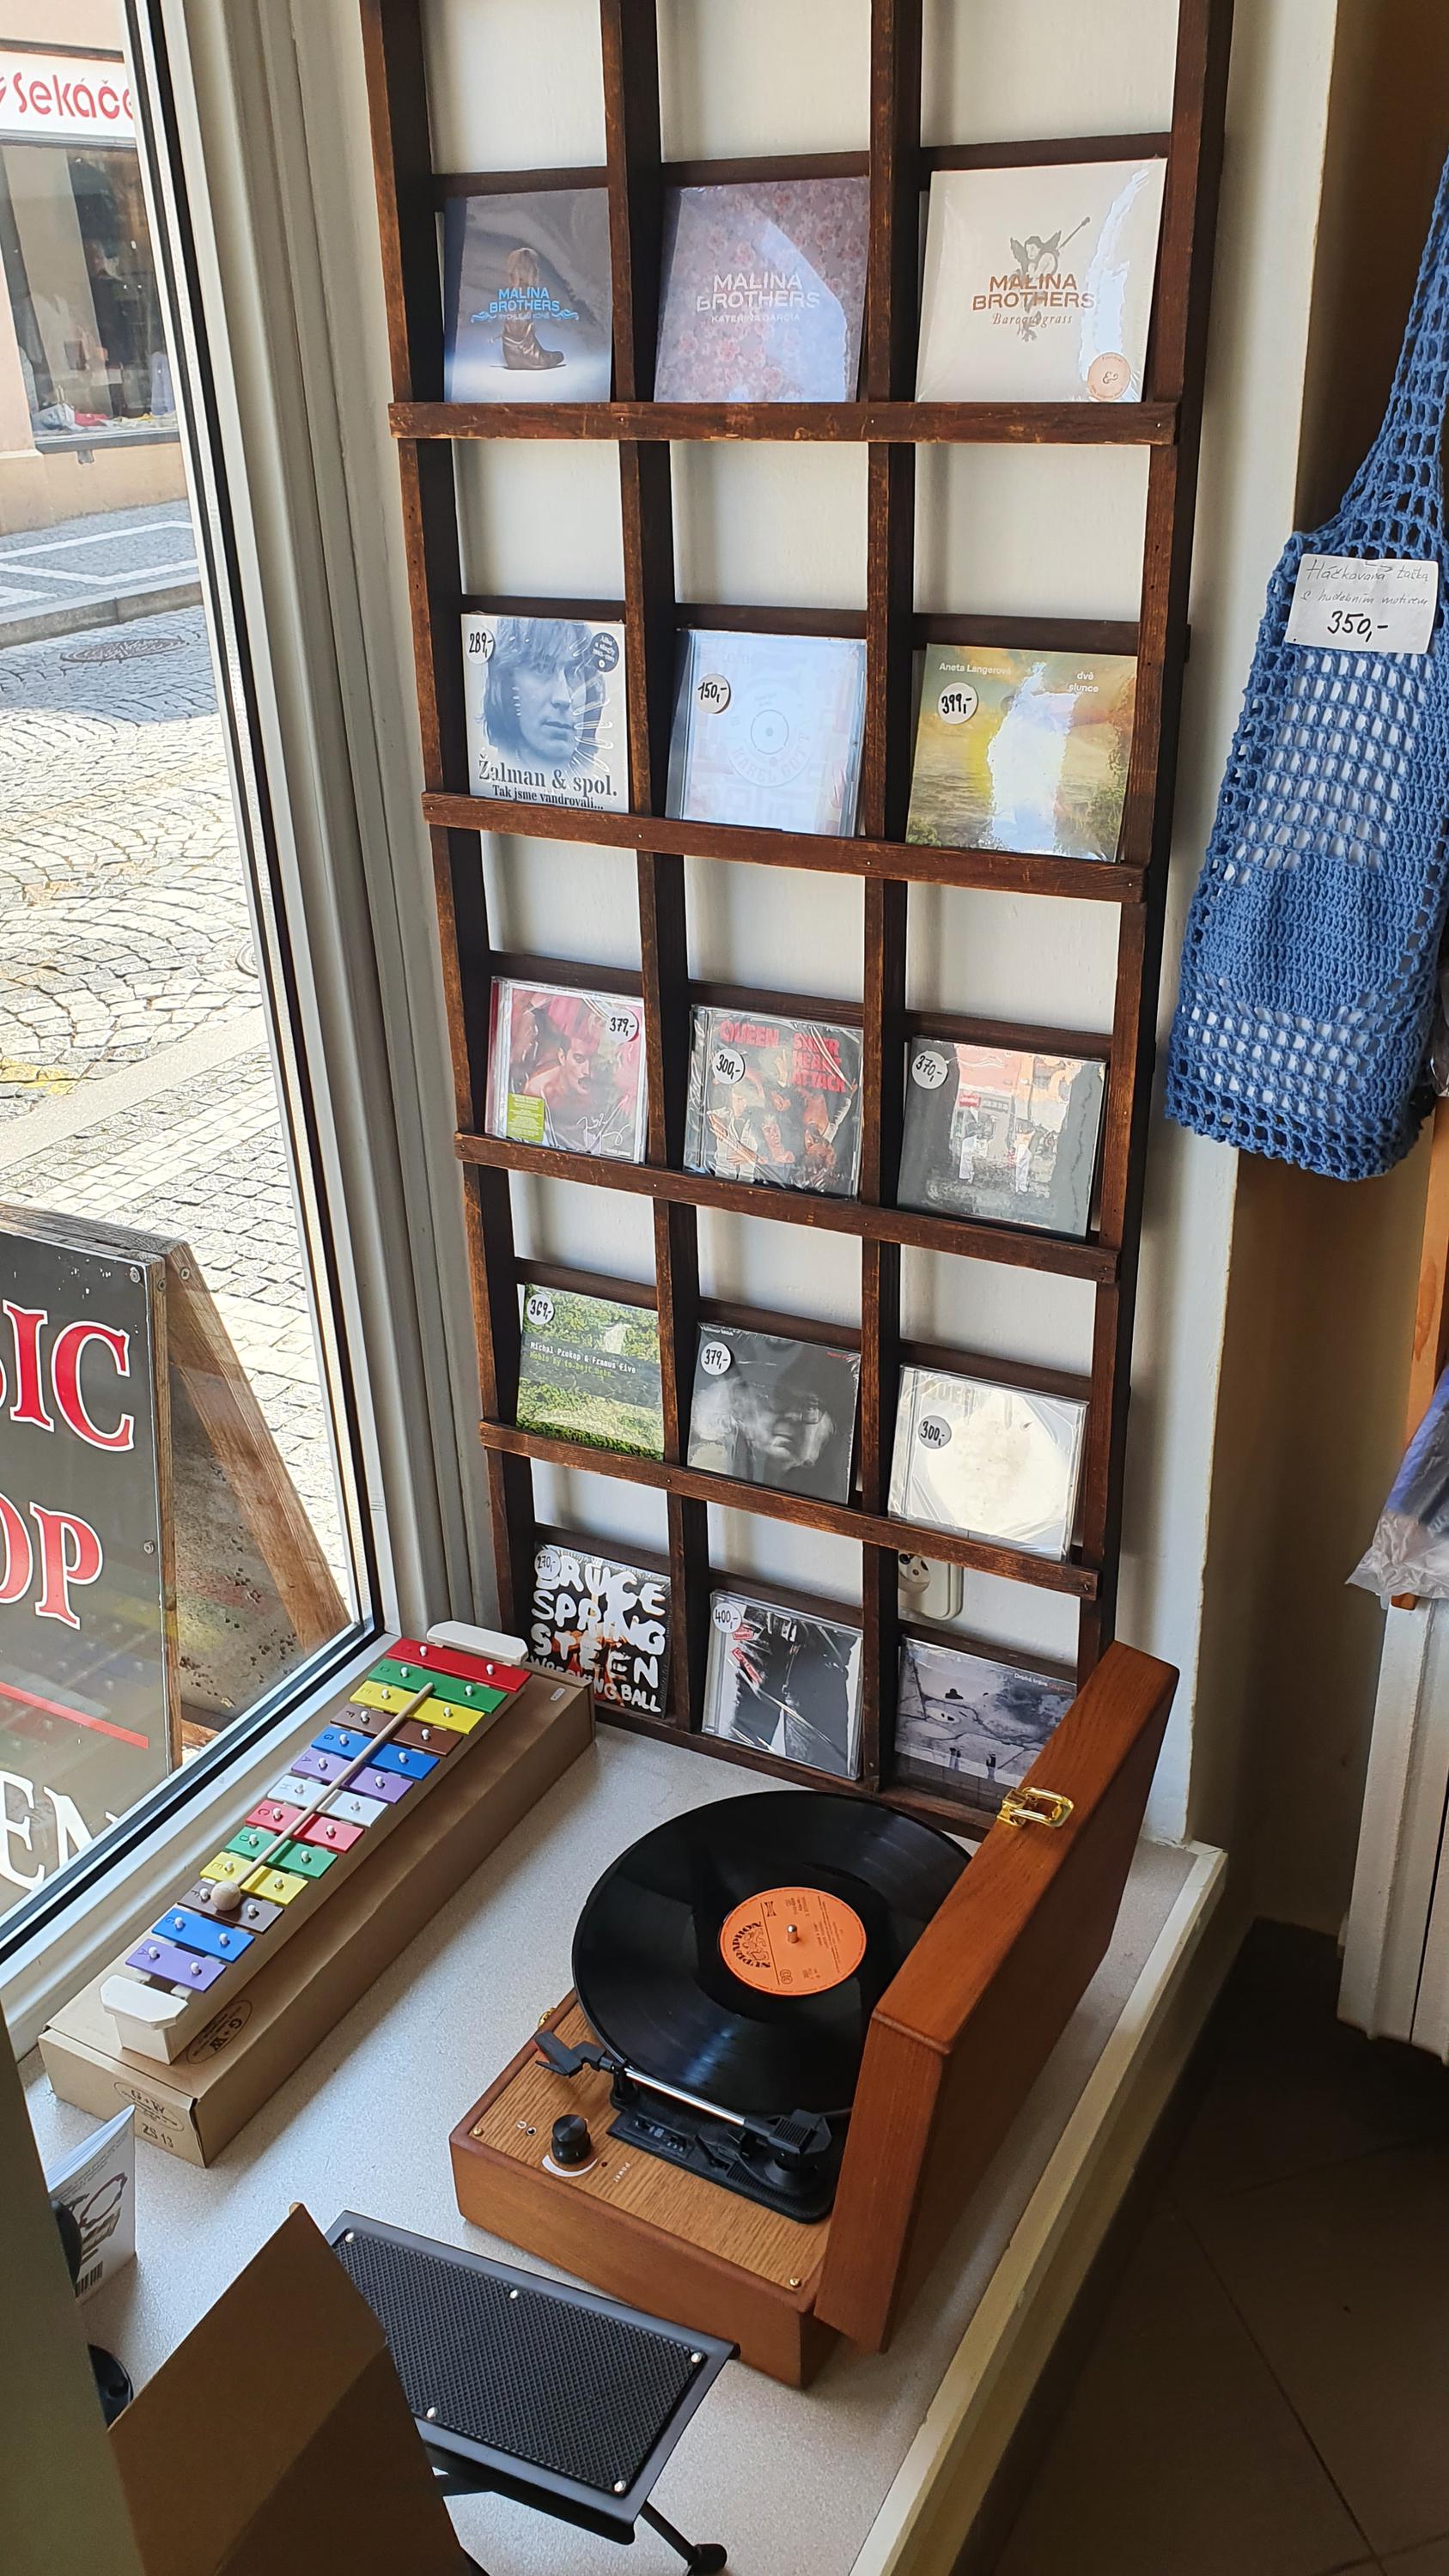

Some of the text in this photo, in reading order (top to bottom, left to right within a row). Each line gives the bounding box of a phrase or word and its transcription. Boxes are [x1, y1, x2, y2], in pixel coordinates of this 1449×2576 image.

[713, 271, 803, 291] MALINA
[989, 273, 1078, 292] MALINA
[497, 287, 550, 300] MALINA
[696, 290, 820, 312] BROTHERS
[971, 291, 1095, 311] BROTHERS
[489, 299, 560, 313] BROTHERS
[939, 662, 965, 672] Aneta
[478, 754, 618, 798] Žalman & spol.
[492, 784, 513, 798] Tak
[513, 787, 538, 801] jsme
[719, 1019, 780, 1048] QUEEN
[0, 1299, 135, 1452] IC
[620, 1683, 662, 1713] BALL
